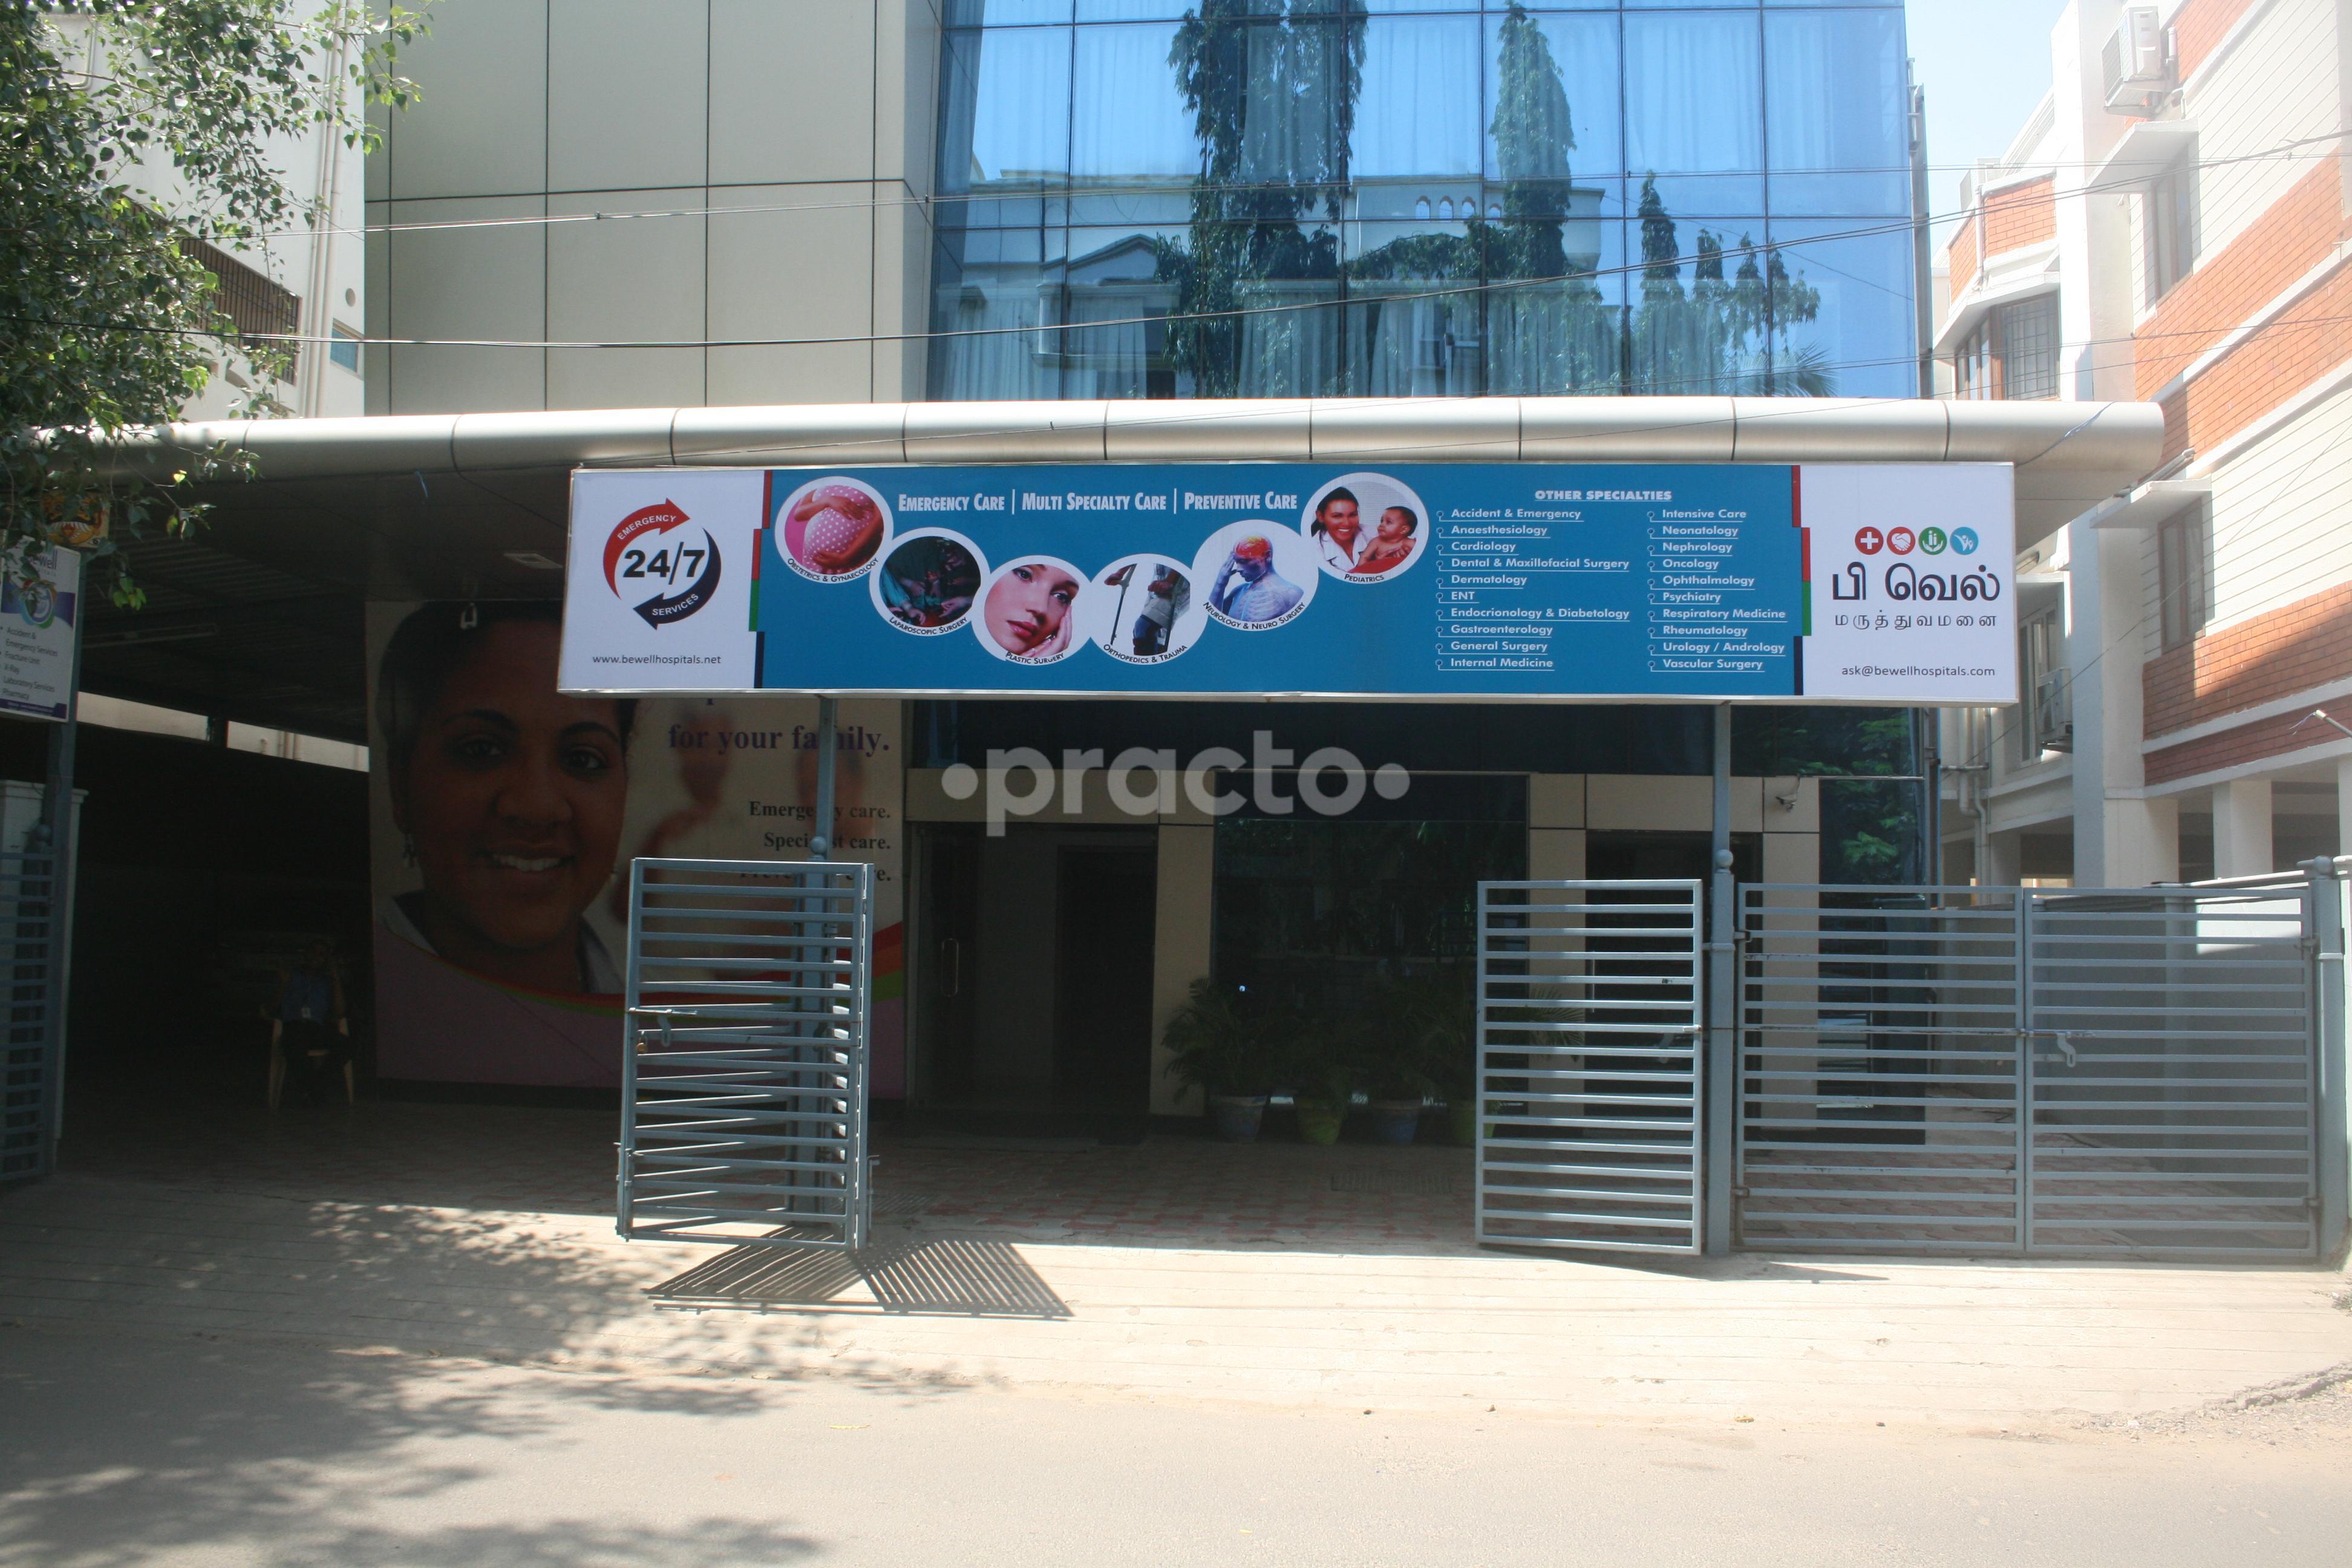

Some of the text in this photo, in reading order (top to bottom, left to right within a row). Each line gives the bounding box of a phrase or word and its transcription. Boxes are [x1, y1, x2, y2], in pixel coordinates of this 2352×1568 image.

[898, 492, 1296, 511] EMERGENCY CARE MULTI SPECIALTY CARE PREVENTIVE CARE
[1535, 491, 1671, 501] OTHER SPECIALTIES
[1451, 509, 1581, 519] Accident & Emergency
[617, 514, 677, 540] EMERGENCY
[1451, 526, 1547, 536] Anaesthesiology
[1663, 526, 1738, 536] Neonatology
[1451, 542, 1516, 552] Cardiology
[1663, 543, 1732, 552] Nephrology
[623, 541, 705, 585] 24/7
[1452, 558, 1629, 569] Dental & Maxillofacial Surgery
[1663, 559, 1719, 569] Oncology
[788, 558, 820, 581] OBSTETRICS
[831, 557, 879, 582] GYNAECOLOGY
[1452, 575, 1527, 586] Dermatology
[1663, 576, 1754, 586] Ophthalmology
[1832, 561, 2000, 601] பி வெல்
[1451, 592, 1475, 600] ENT
[1663, 592, 1721, 603] Psychiatry
[652, 593, 699, 616] SERVICES
[1203, 602, 1241, 629] NEUROLOGY
[1252, 621, 1277, 630] NEURO
[1278, 602, 1305, 624] SURGERY
[1451, 608, 1629, 619] Endocrionology & Diabetology
[1663, 609, 1785, 619] Respiratory Medicine
[889, 616, 968, 635] LAPAROSCOPIC SURGERY
[1451, 625, 1553, 635] Gastroenterology
[1663, 626, 1747, 636] Rheumatology
[1451, 641, 1547, 652] General Surgery
[1664, 643, 1785, 653] Urology / Andrology
[1005, 651, 1064, 664] PLASTIC SURGERY
[1103, 644, 1149, 663] ORTHOPEDICS
[1159, 645, 1188, 661] TRAUMA
[593, 655, 721, 665] www.bewellhospitals.net
[1451, 658, 1553, 667] Internal Medicine
[1717, 660, 1763, 670] Surgery
[1842, 666, 1995, 677] ask@bewellhospitals.com
[669, 725, 709, 749] for
[717, 731, 783, 756] your
[750, 801, 890, 821] Emergey care.
[764, 832, 890, 851] Specist care.
